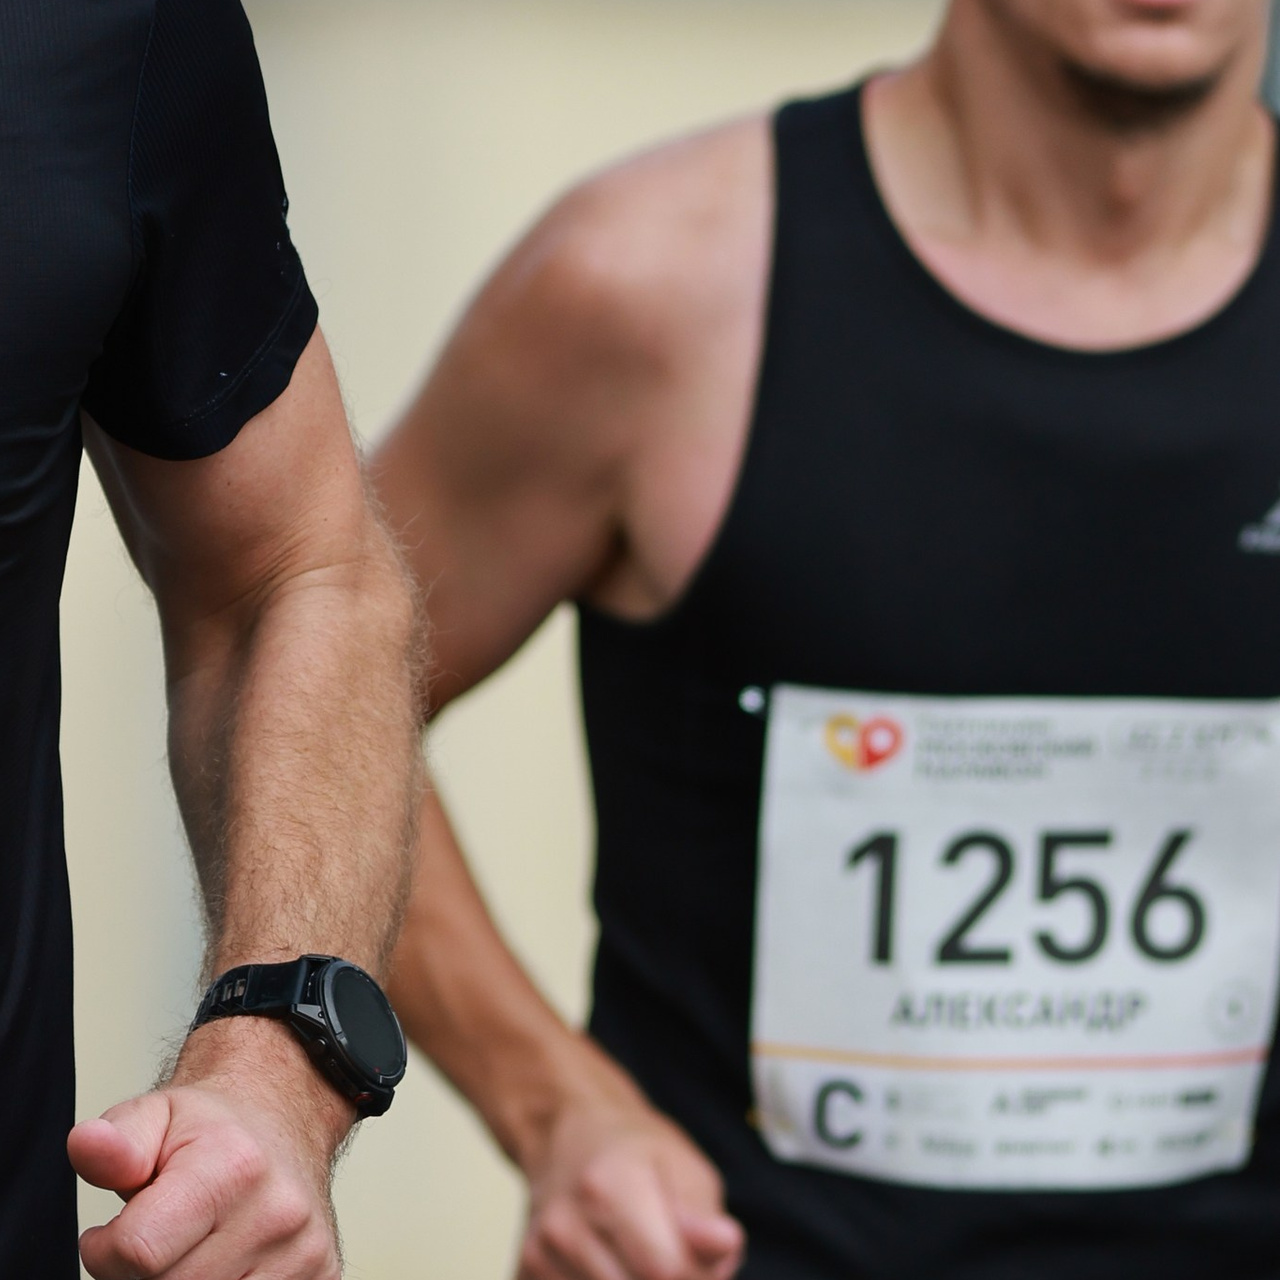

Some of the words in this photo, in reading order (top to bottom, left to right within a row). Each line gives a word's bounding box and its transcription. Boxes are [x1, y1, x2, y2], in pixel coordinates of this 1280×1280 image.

[846, 829, 1206, 966] 1256
[891, 992, 1145, 1033] АЛЕКСАНДР
[813, 1079, 865, 1151] C
